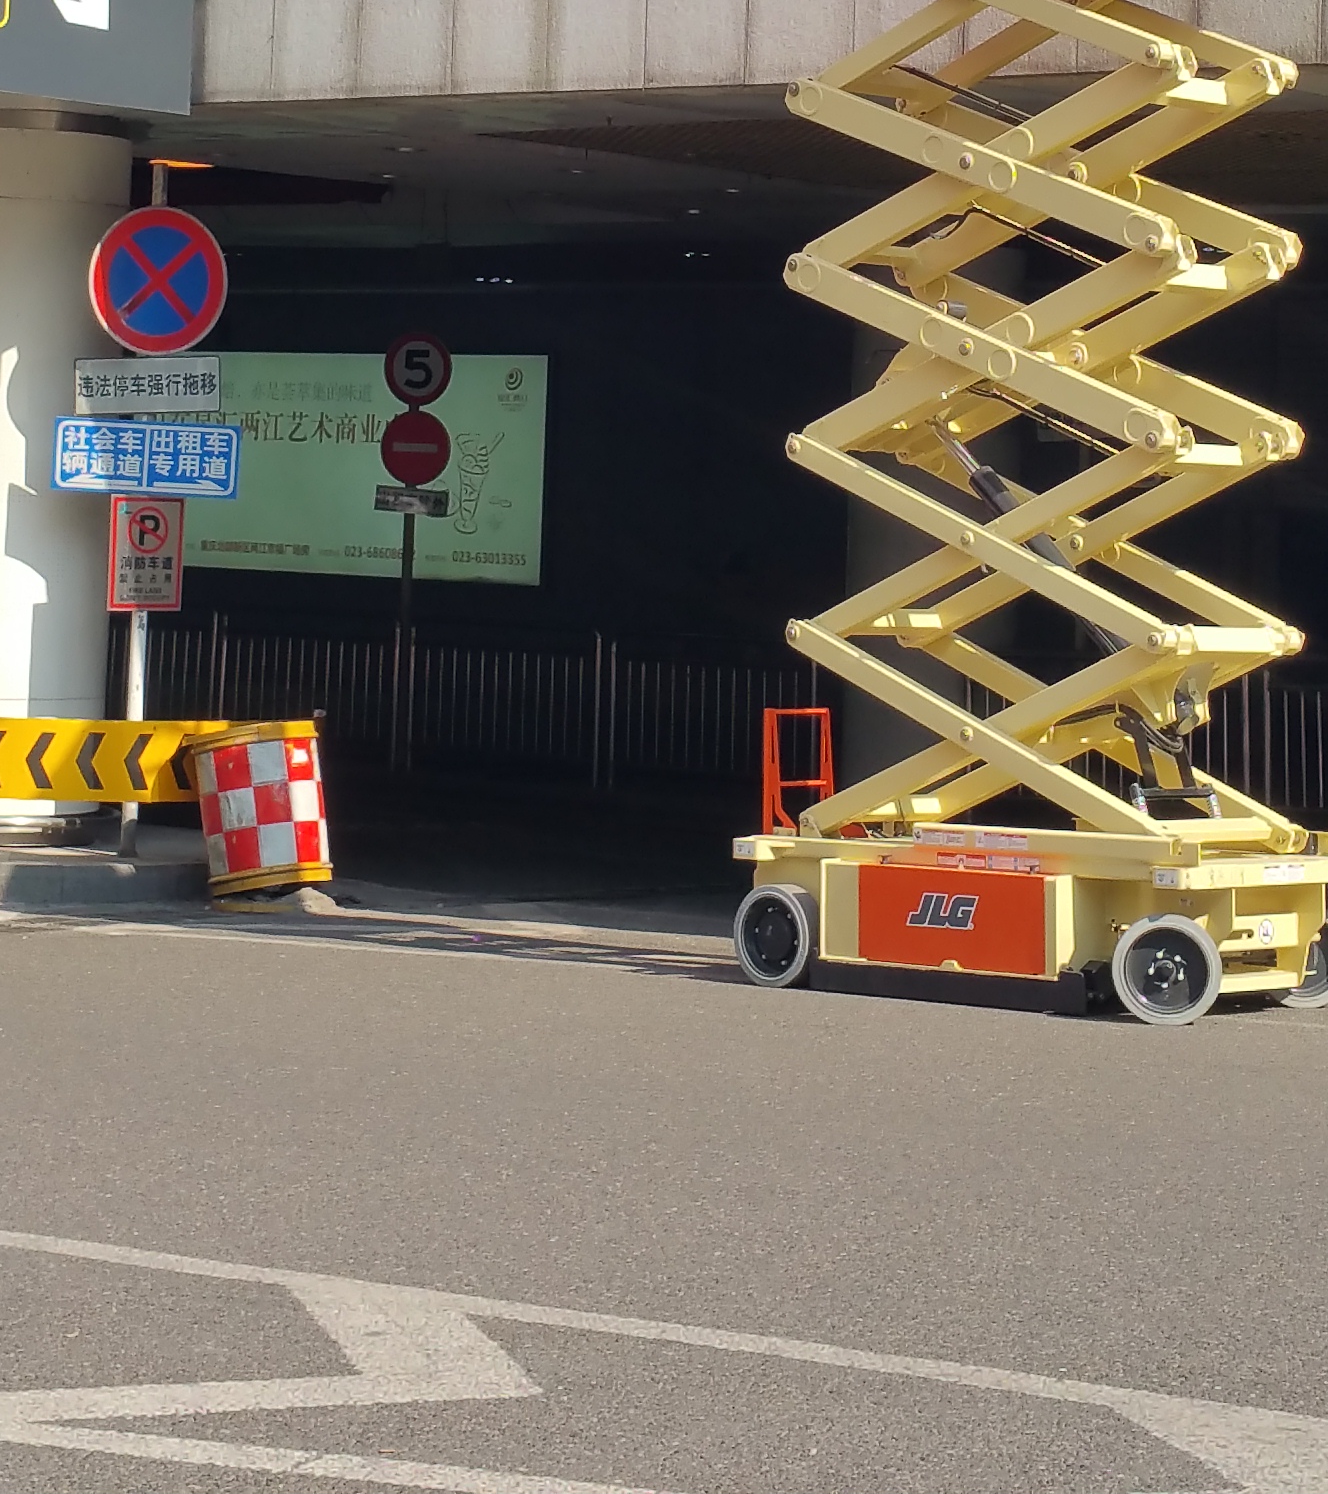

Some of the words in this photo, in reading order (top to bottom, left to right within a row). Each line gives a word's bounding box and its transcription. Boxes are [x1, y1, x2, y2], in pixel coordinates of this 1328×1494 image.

[404, 349, 432, 389] 5
[77, 372, 218, 398] 违法停车强行拖移
[65, 426, 143, 453] 社会车
[151, 430, 230, 455] 出租车
[62, 451, 143, 478] 辆通道
[150, 455, 228, 480] 专用道
[906, 892, 979, 929] JLG
